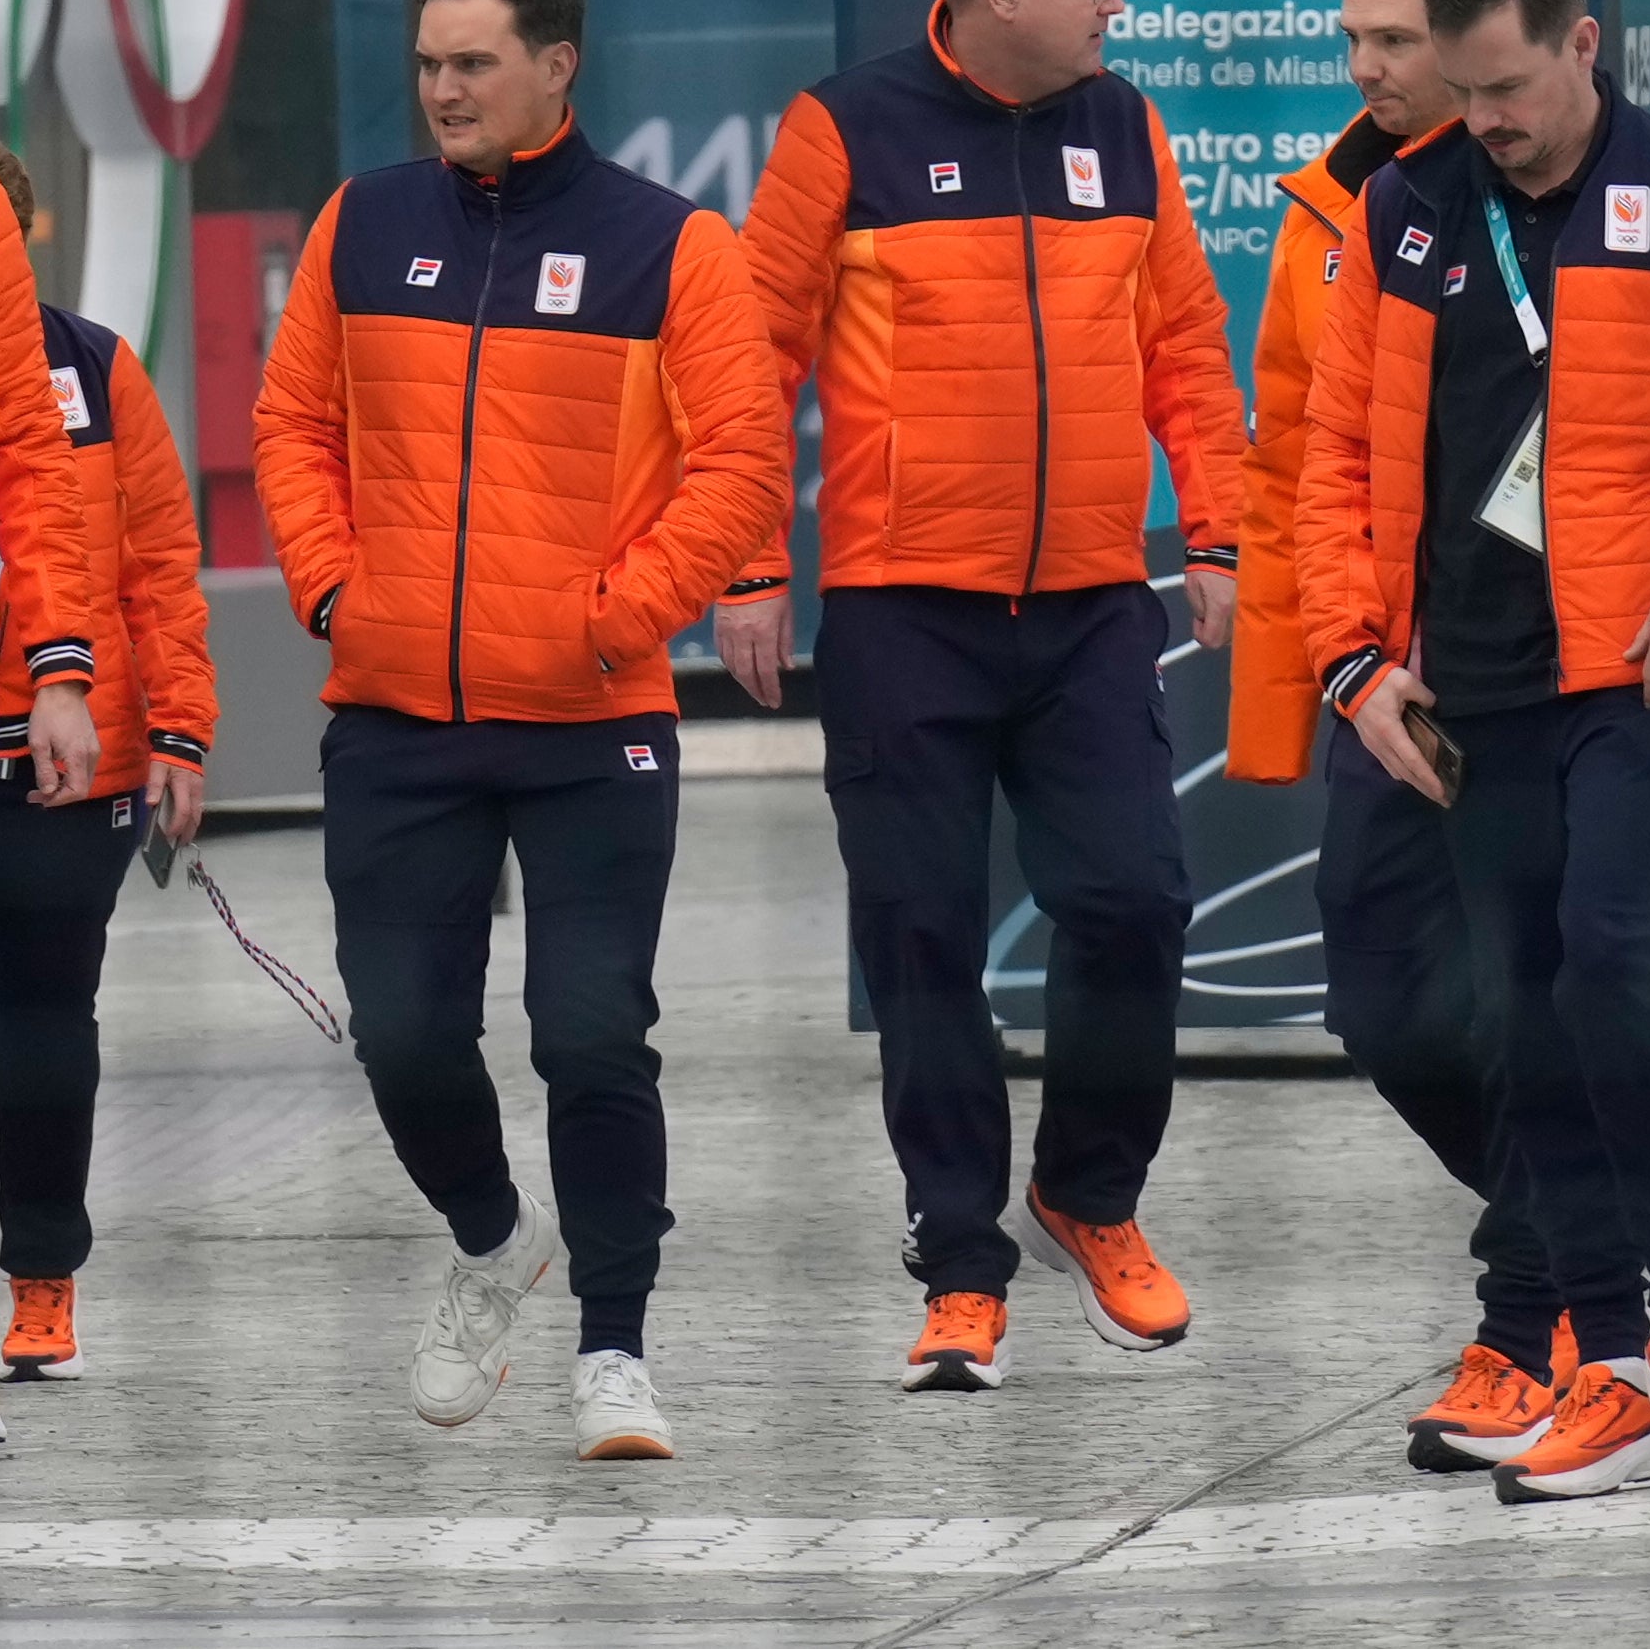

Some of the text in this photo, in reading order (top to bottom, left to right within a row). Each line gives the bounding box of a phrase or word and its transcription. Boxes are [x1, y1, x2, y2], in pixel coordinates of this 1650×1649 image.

[1107, 0, 1342, 48] delegazion
[1211, 54, 1256, 84] de
[1265, 55, 1354, 84] Missi
[1168, 129, 1262, 162] ntro
